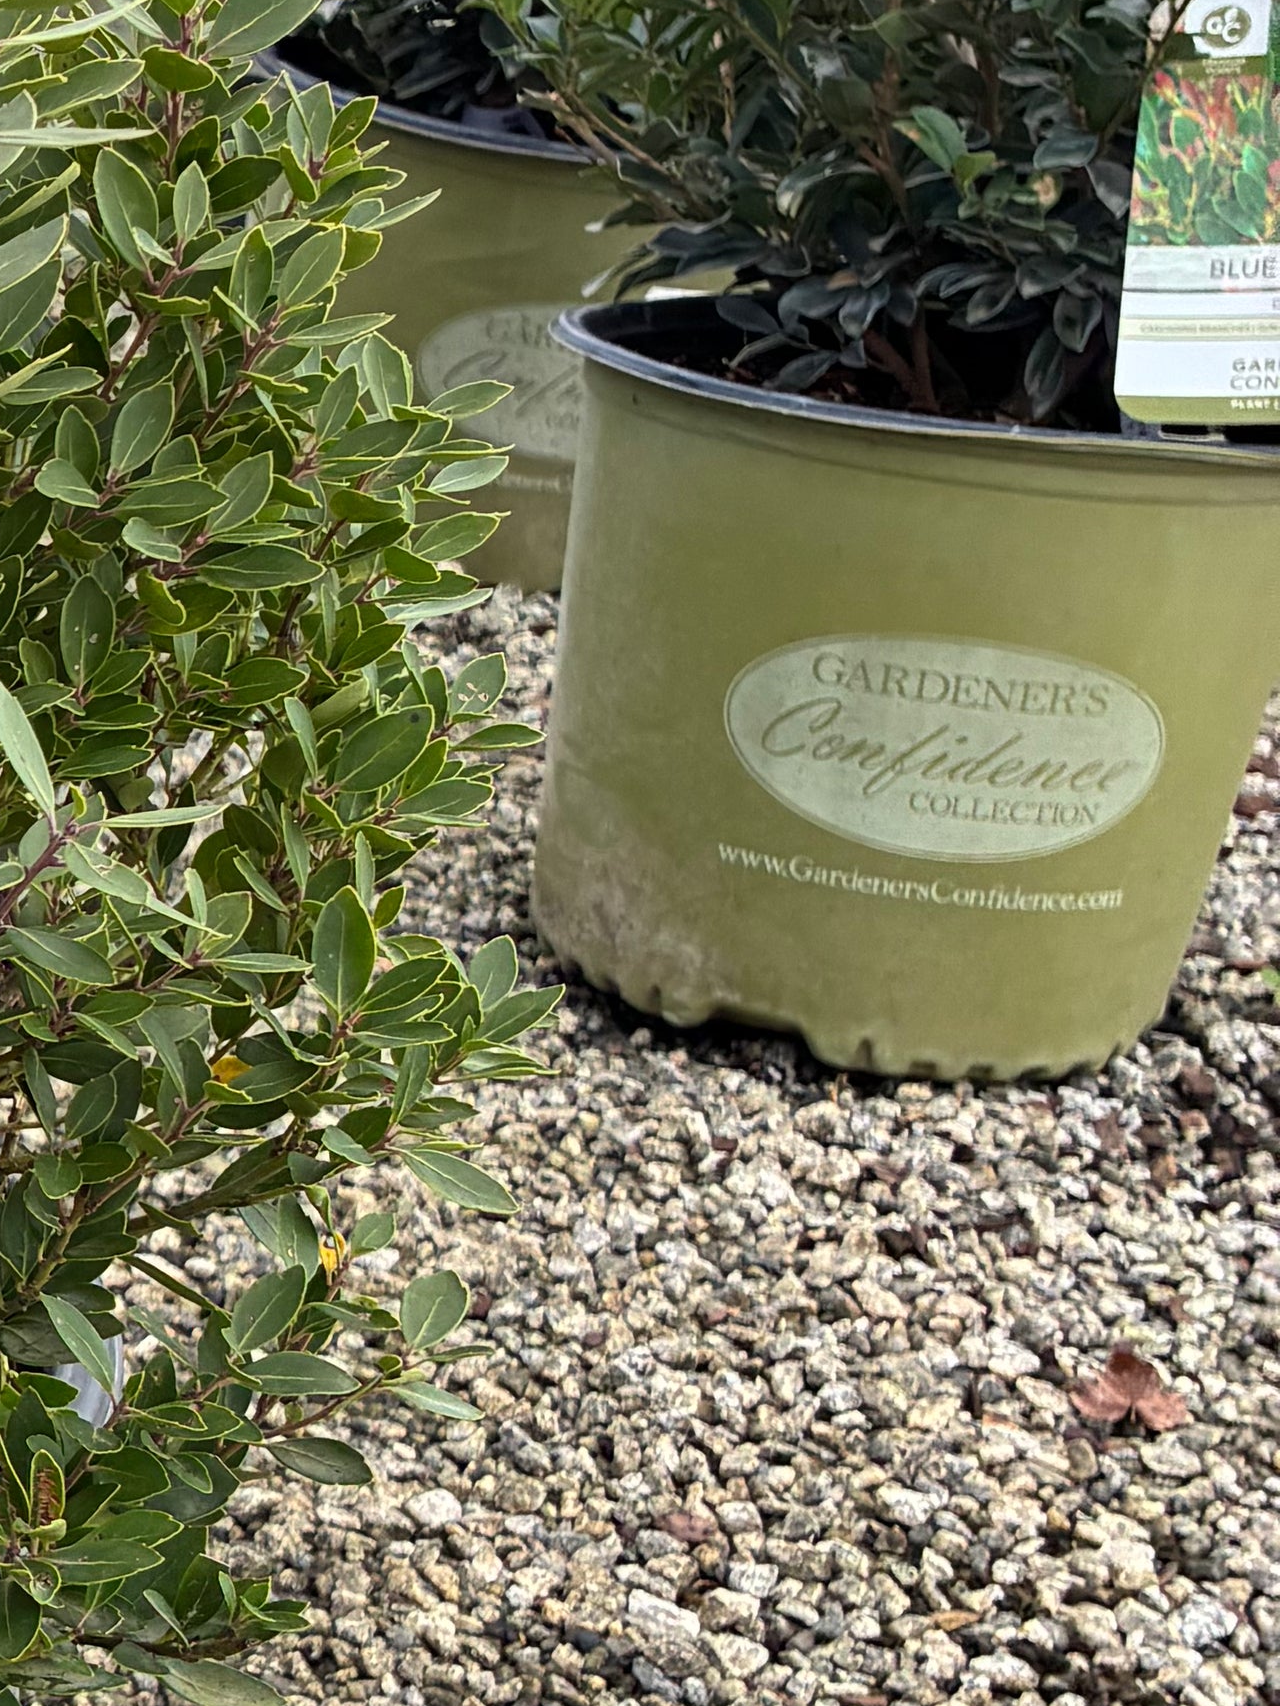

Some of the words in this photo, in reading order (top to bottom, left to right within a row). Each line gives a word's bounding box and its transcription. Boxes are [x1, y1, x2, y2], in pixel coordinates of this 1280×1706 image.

[1232, 357, 1280, 373] GAR
[760, 696, 1138, 796] Confidence
[908, 792, 1102, 828] COLLECTION
[718, 842, 1124, 913] www.GardenersConfidence.com
